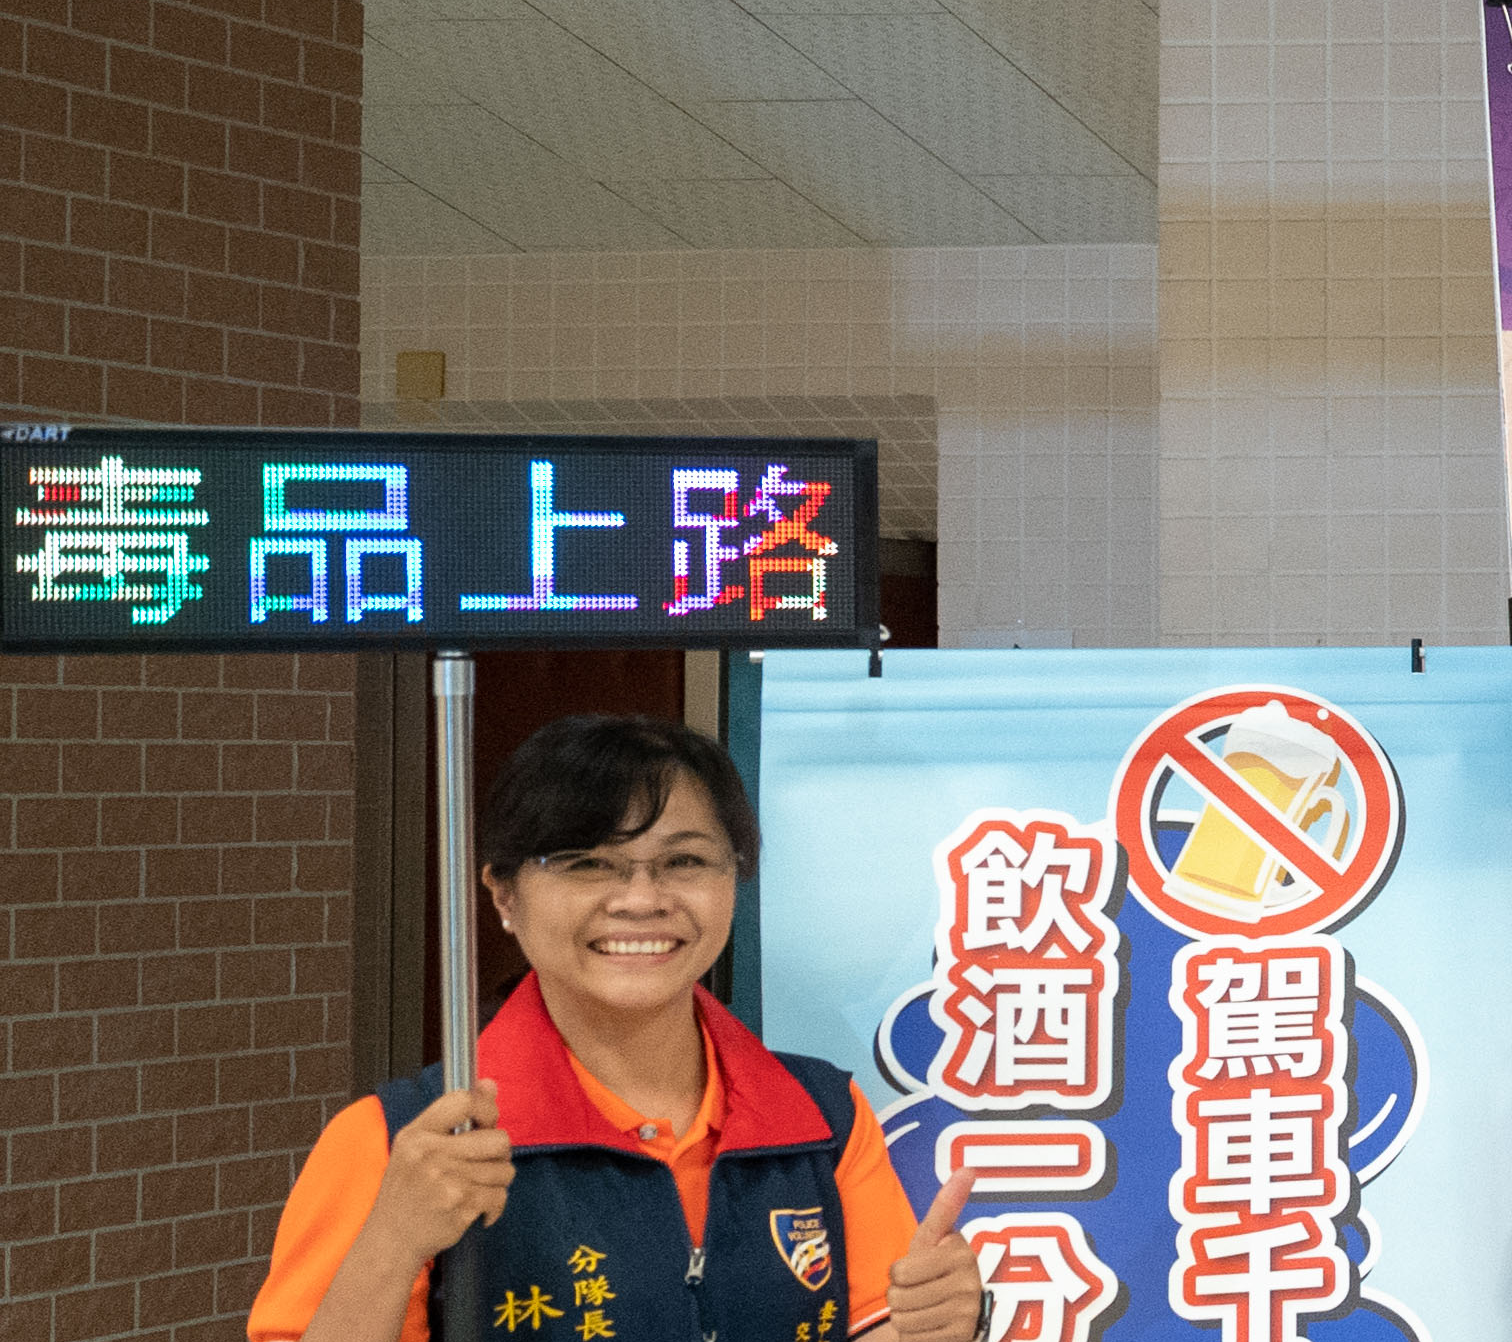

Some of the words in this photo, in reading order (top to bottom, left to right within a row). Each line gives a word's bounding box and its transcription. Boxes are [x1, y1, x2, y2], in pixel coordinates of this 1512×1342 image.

[15, 455, 838, 624] 毒品上路
[568, 1244, 616, 1342] 分隊長
